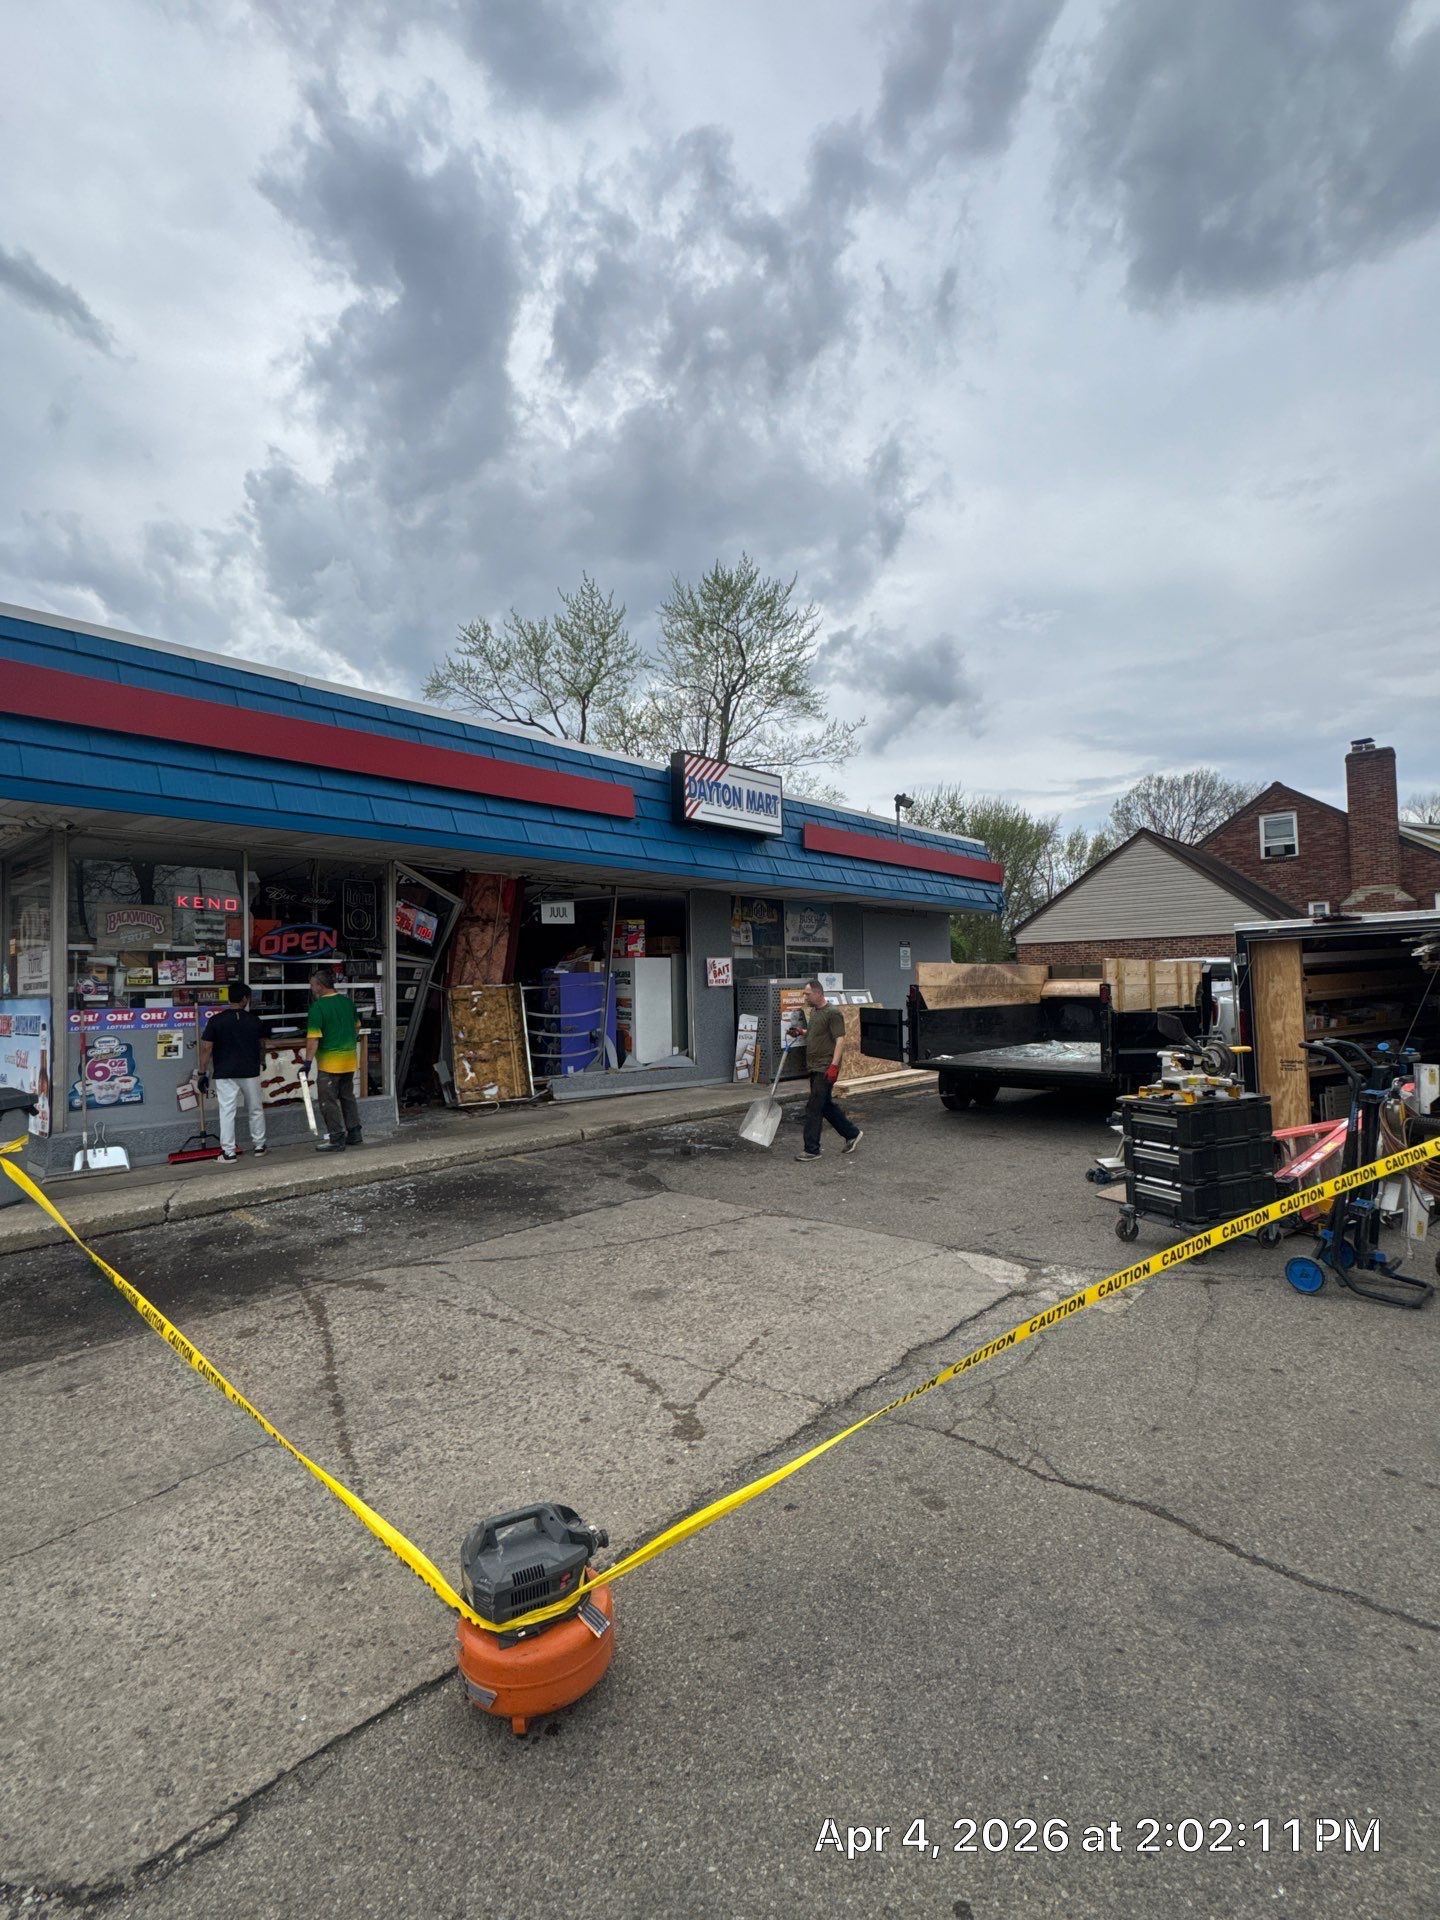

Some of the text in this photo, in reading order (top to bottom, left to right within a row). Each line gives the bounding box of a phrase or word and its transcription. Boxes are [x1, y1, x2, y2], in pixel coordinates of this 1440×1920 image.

[687, 775, 780, 819] DAYTON MART
[176, 895, 239, 912] KENO
[550, 906, 568, 919] JUUL
[106, 909, 165, 935] BACKWOODS
[258, 929, 338, 956] OPEN
[713, 963, 730, 979] BAIT
[105, 1012, 134, 1022] OH!
[140, 1011, 168, 1021] OH!
[952, 1331, 1017, 1375] CAUTION
[1028, 1293, 1086, 1334] CAUTION
[1097, 1261, 1151, 1298] CAUTION
[1161, 1233, 1212, 1267] CAUTION
[1221, 1209, 1271, 1239] CAUTION
[1279, 1186, 1326, 1215] CAUTION
[1333, 1165, 1378, 1192] CAUTION
[1385, 1146, 1428, 1172] CAUTION
[117, 1280, 141, 1307] CAUTION
[141, 1304, 167, 1333] CAUTION
[167, 1330, 195, 1363] CAUTION
[197, 1359, 227, 1396] CAUTION
